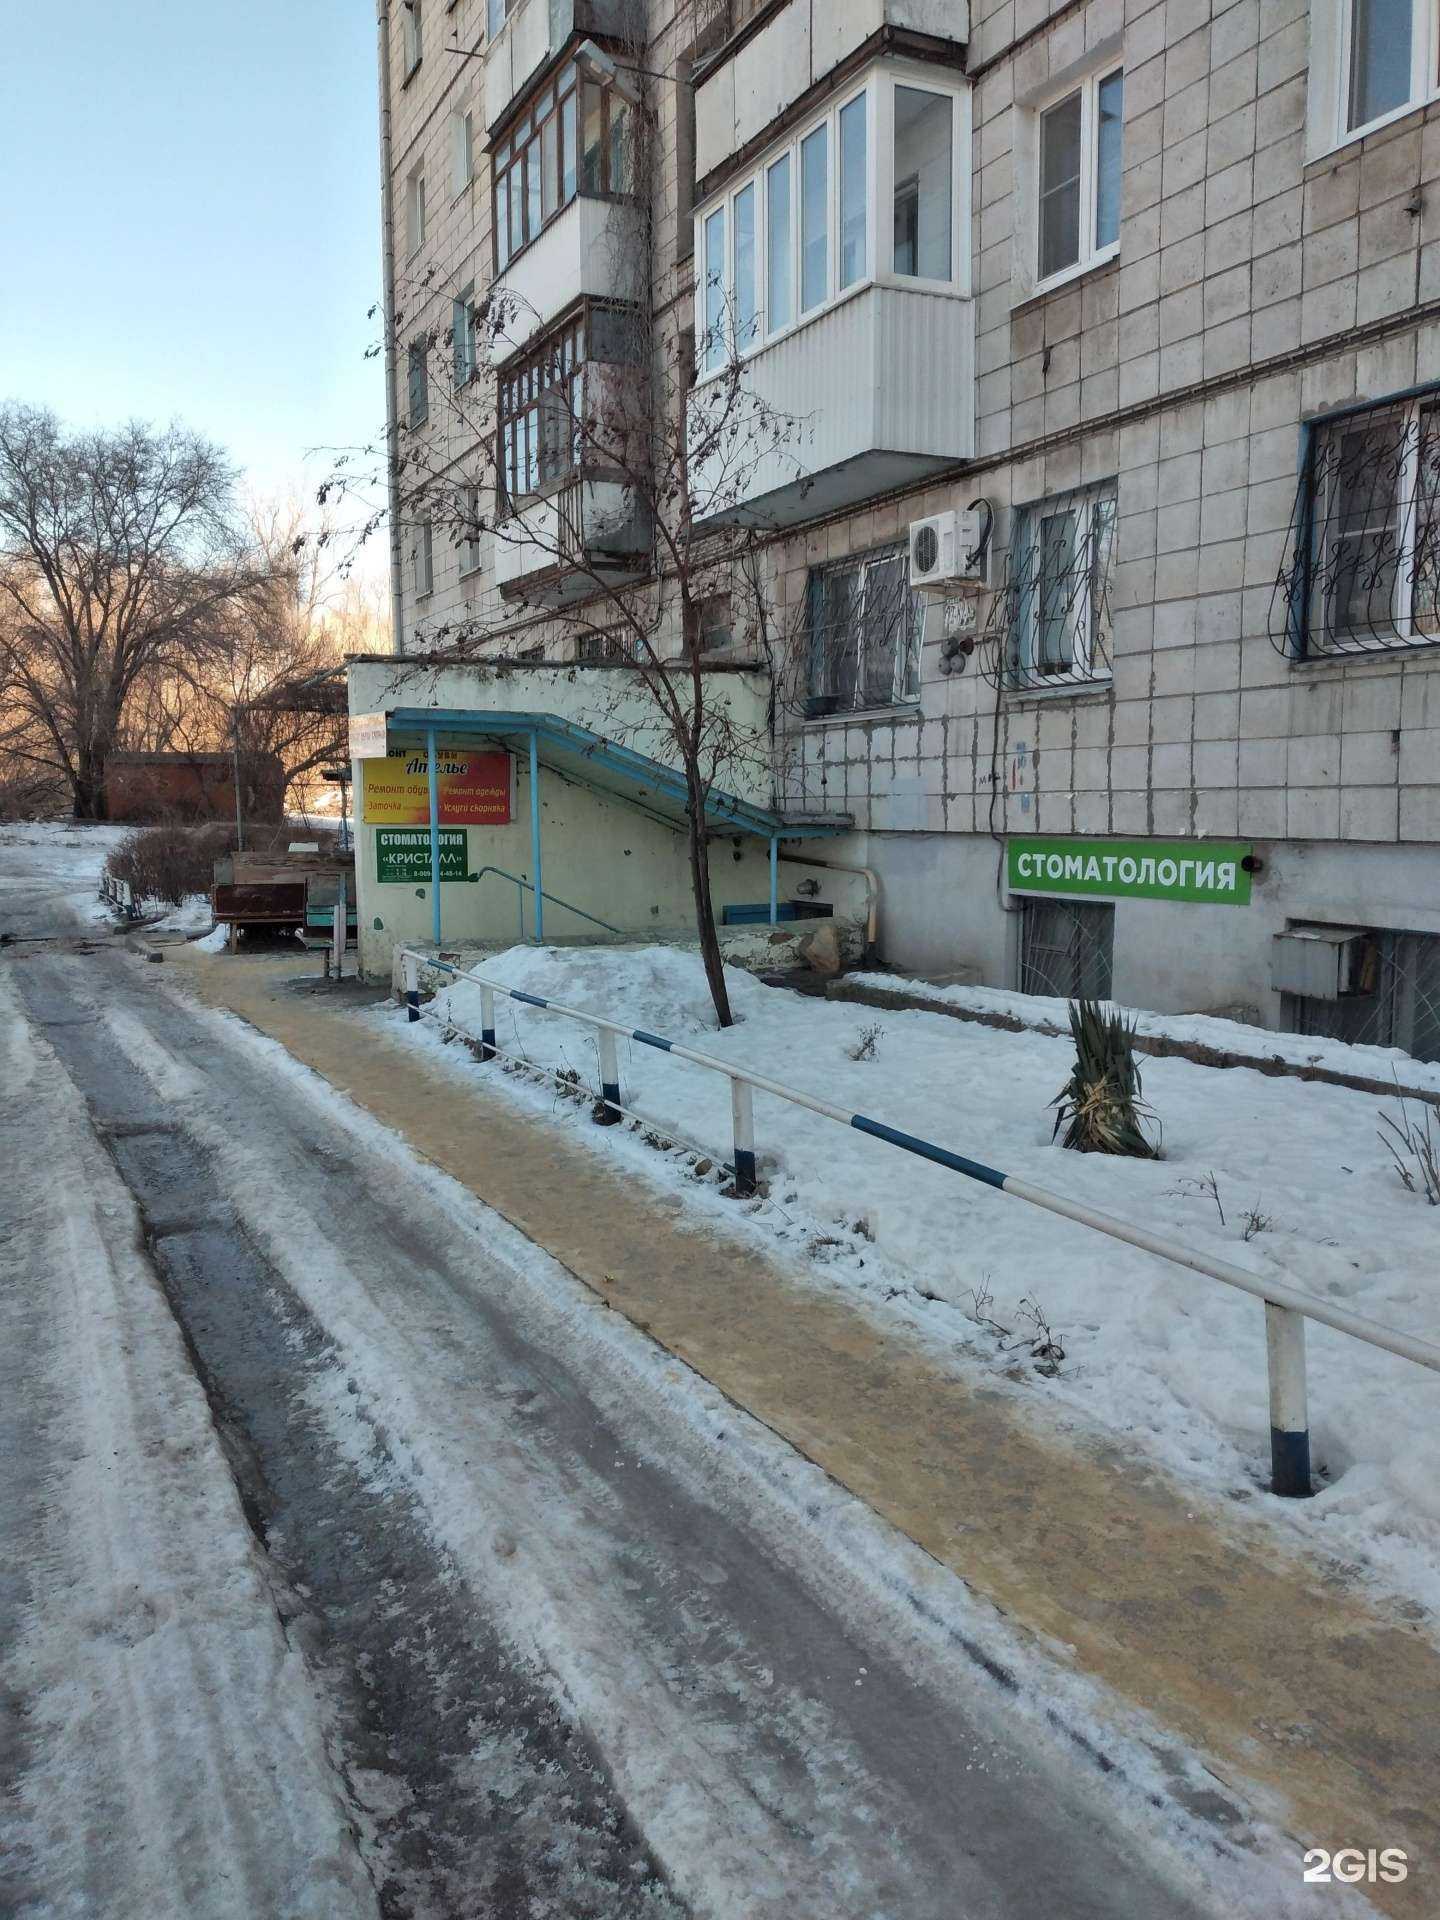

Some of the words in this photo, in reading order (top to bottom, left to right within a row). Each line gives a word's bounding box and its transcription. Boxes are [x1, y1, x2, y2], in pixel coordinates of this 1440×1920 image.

[368, 784, 404, 795] Ремонт
[475, 786, 505, 798] одежды
[368, 800, 402, 811] Заточка
[443, 802, 468, 813] Услуги
[469, 803, 505, 813] скорняка
[1018, 853, 1236, 890] СТОМАТОЛОГИЯ
